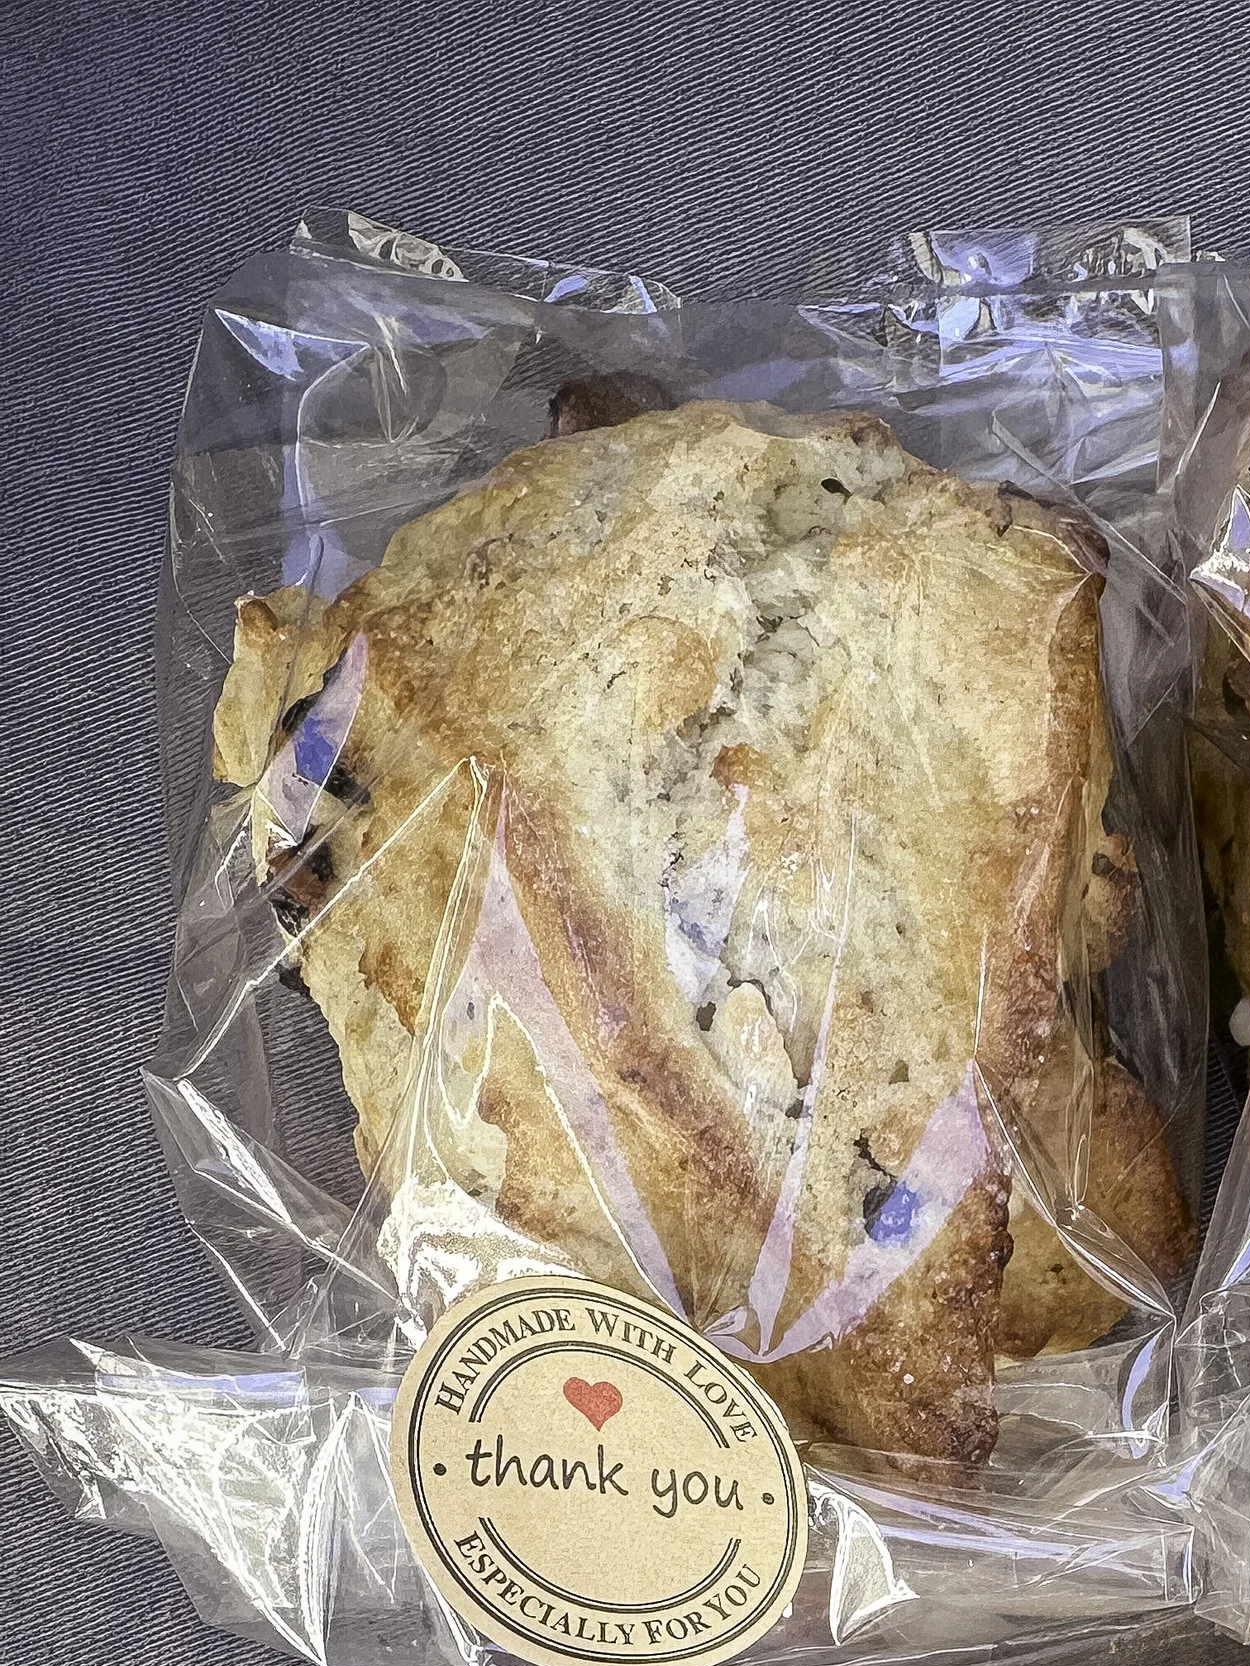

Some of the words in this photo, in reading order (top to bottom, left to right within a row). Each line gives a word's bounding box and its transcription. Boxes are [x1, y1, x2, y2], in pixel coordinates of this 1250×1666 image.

[434, 1308, 576, 1415] HANDMADE
[585, 1307, 677, 1363] WITH
[684, 1360, 758, 1443] LOVE
[465, 1434, 629, 1496] thank
[651, 1468, 743, 1518] you
[454, 1531, 635, 1646] ESPECIALLY
[645, 1613, 711, 1645] FOR
[702, 1564, 763, 1622] YOU
